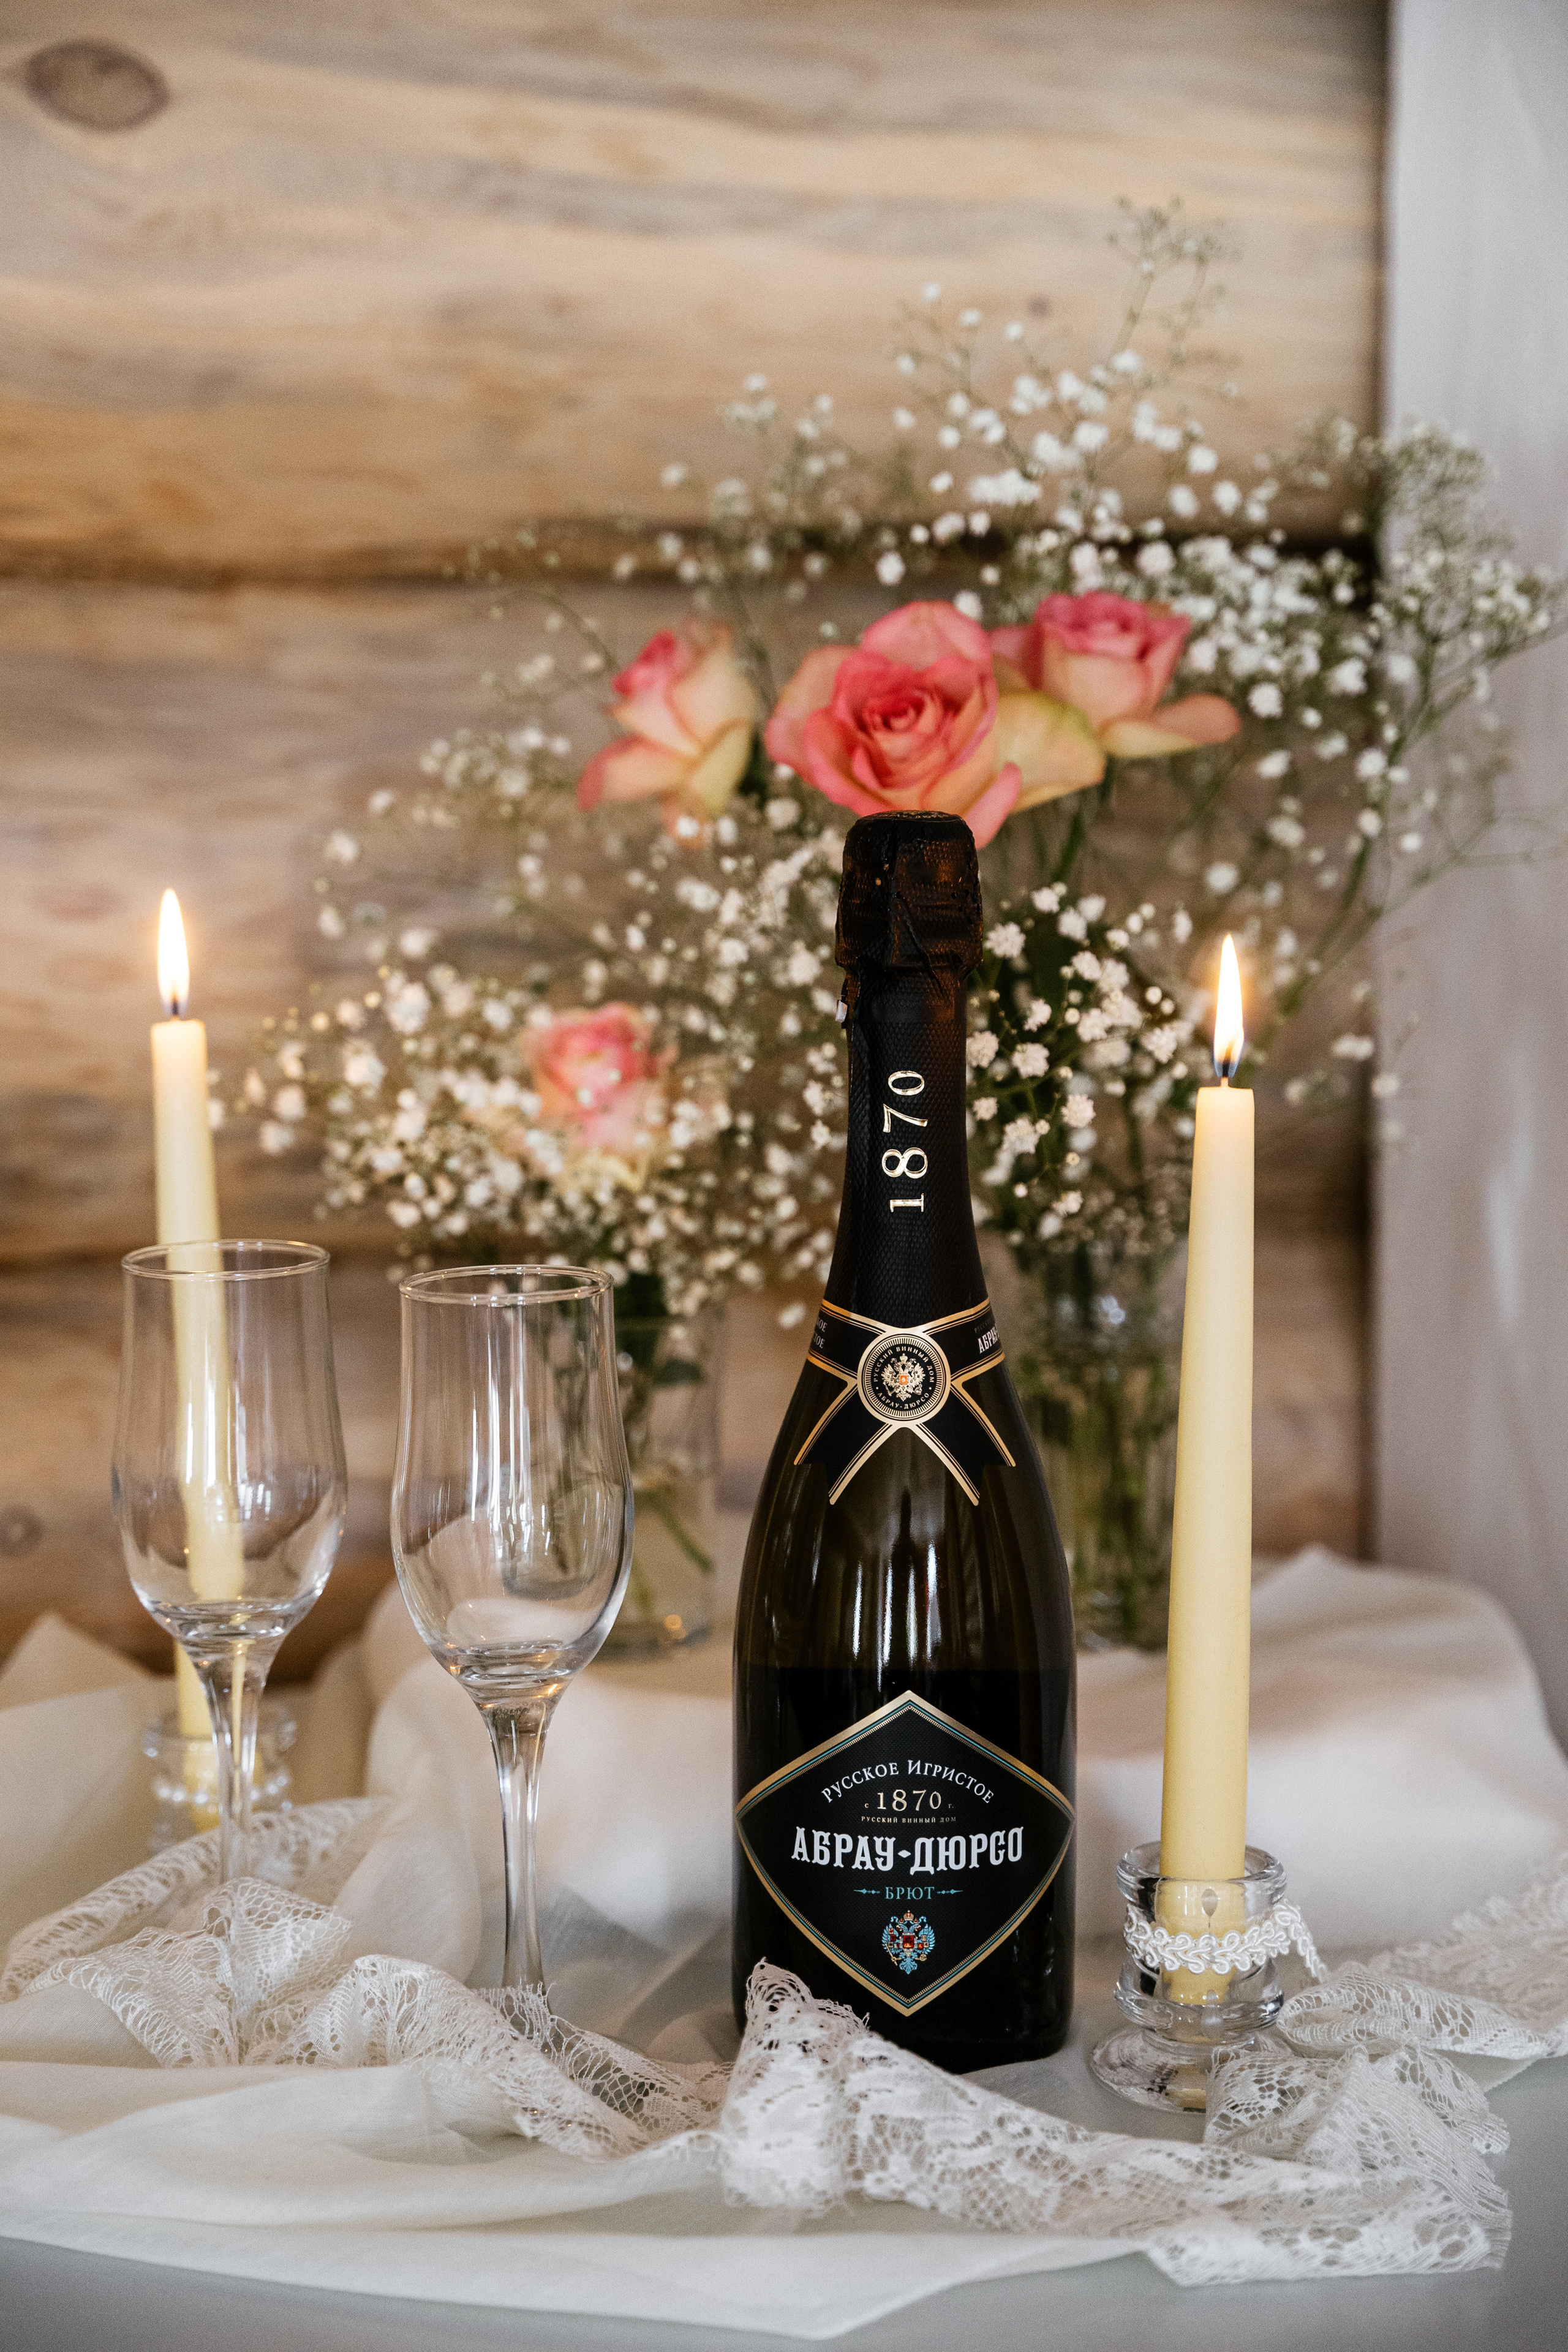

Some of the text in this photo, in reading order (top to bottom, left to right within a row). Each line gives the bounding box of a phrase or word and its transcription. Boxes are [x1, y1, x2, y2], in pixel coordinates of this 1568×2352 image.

[882, 1071, 928, 1212] 1870
[874, 1349, 893, 1382] РУССКИЙ
[896, 1346, 929, 1363] ВИННЫЙ
[878, 1392, 929, 1409] АБРАУ-ДЮРСО
[821, 1760, 994, 1804] РУССКОЕ ИГРИСТОЕ
[877, 1790, 942, 1811] 1870
[885, 1887, 935, 1900] БРЮТ
